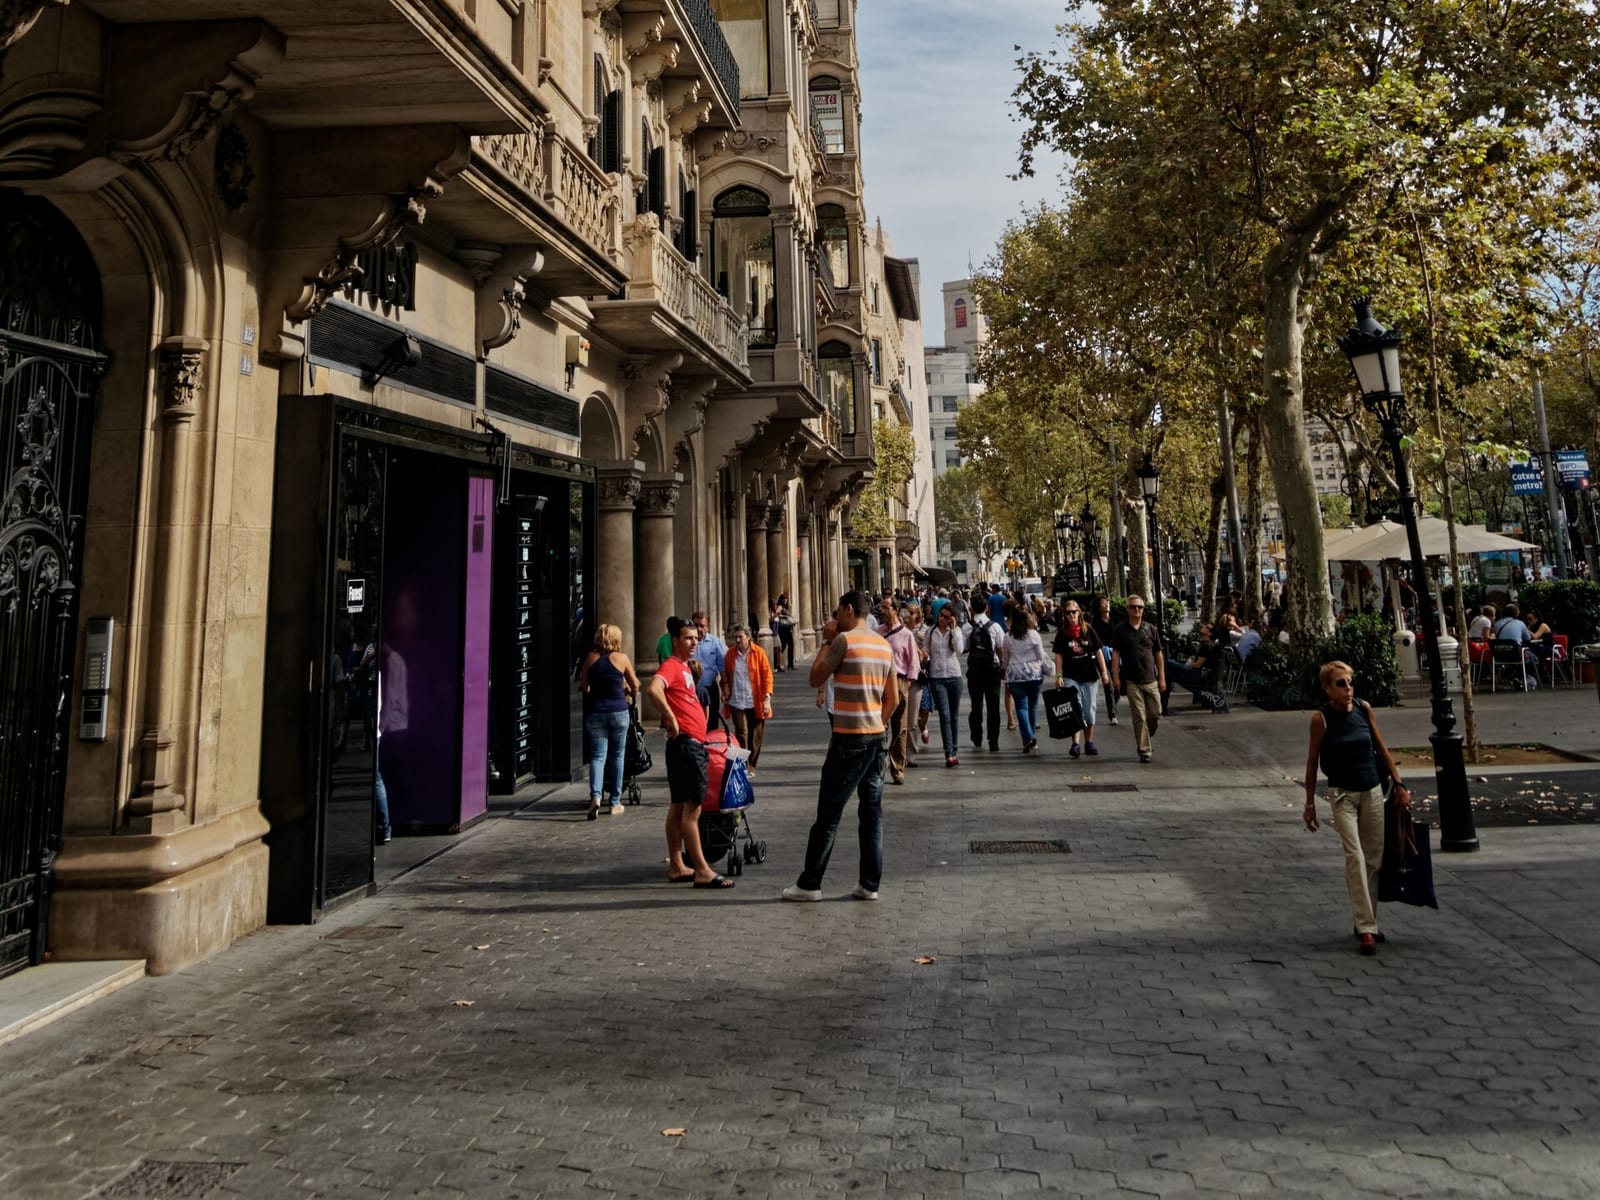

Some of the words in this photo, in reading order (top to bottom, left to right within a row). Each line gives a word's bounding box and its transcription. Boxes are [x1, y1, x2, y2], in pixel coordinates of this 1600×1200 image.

[1512, 472, 1535, 481] Cotxe
[1513, 481, 1543, 490] metro?
[1052, 701, 1073, 717] VANS
